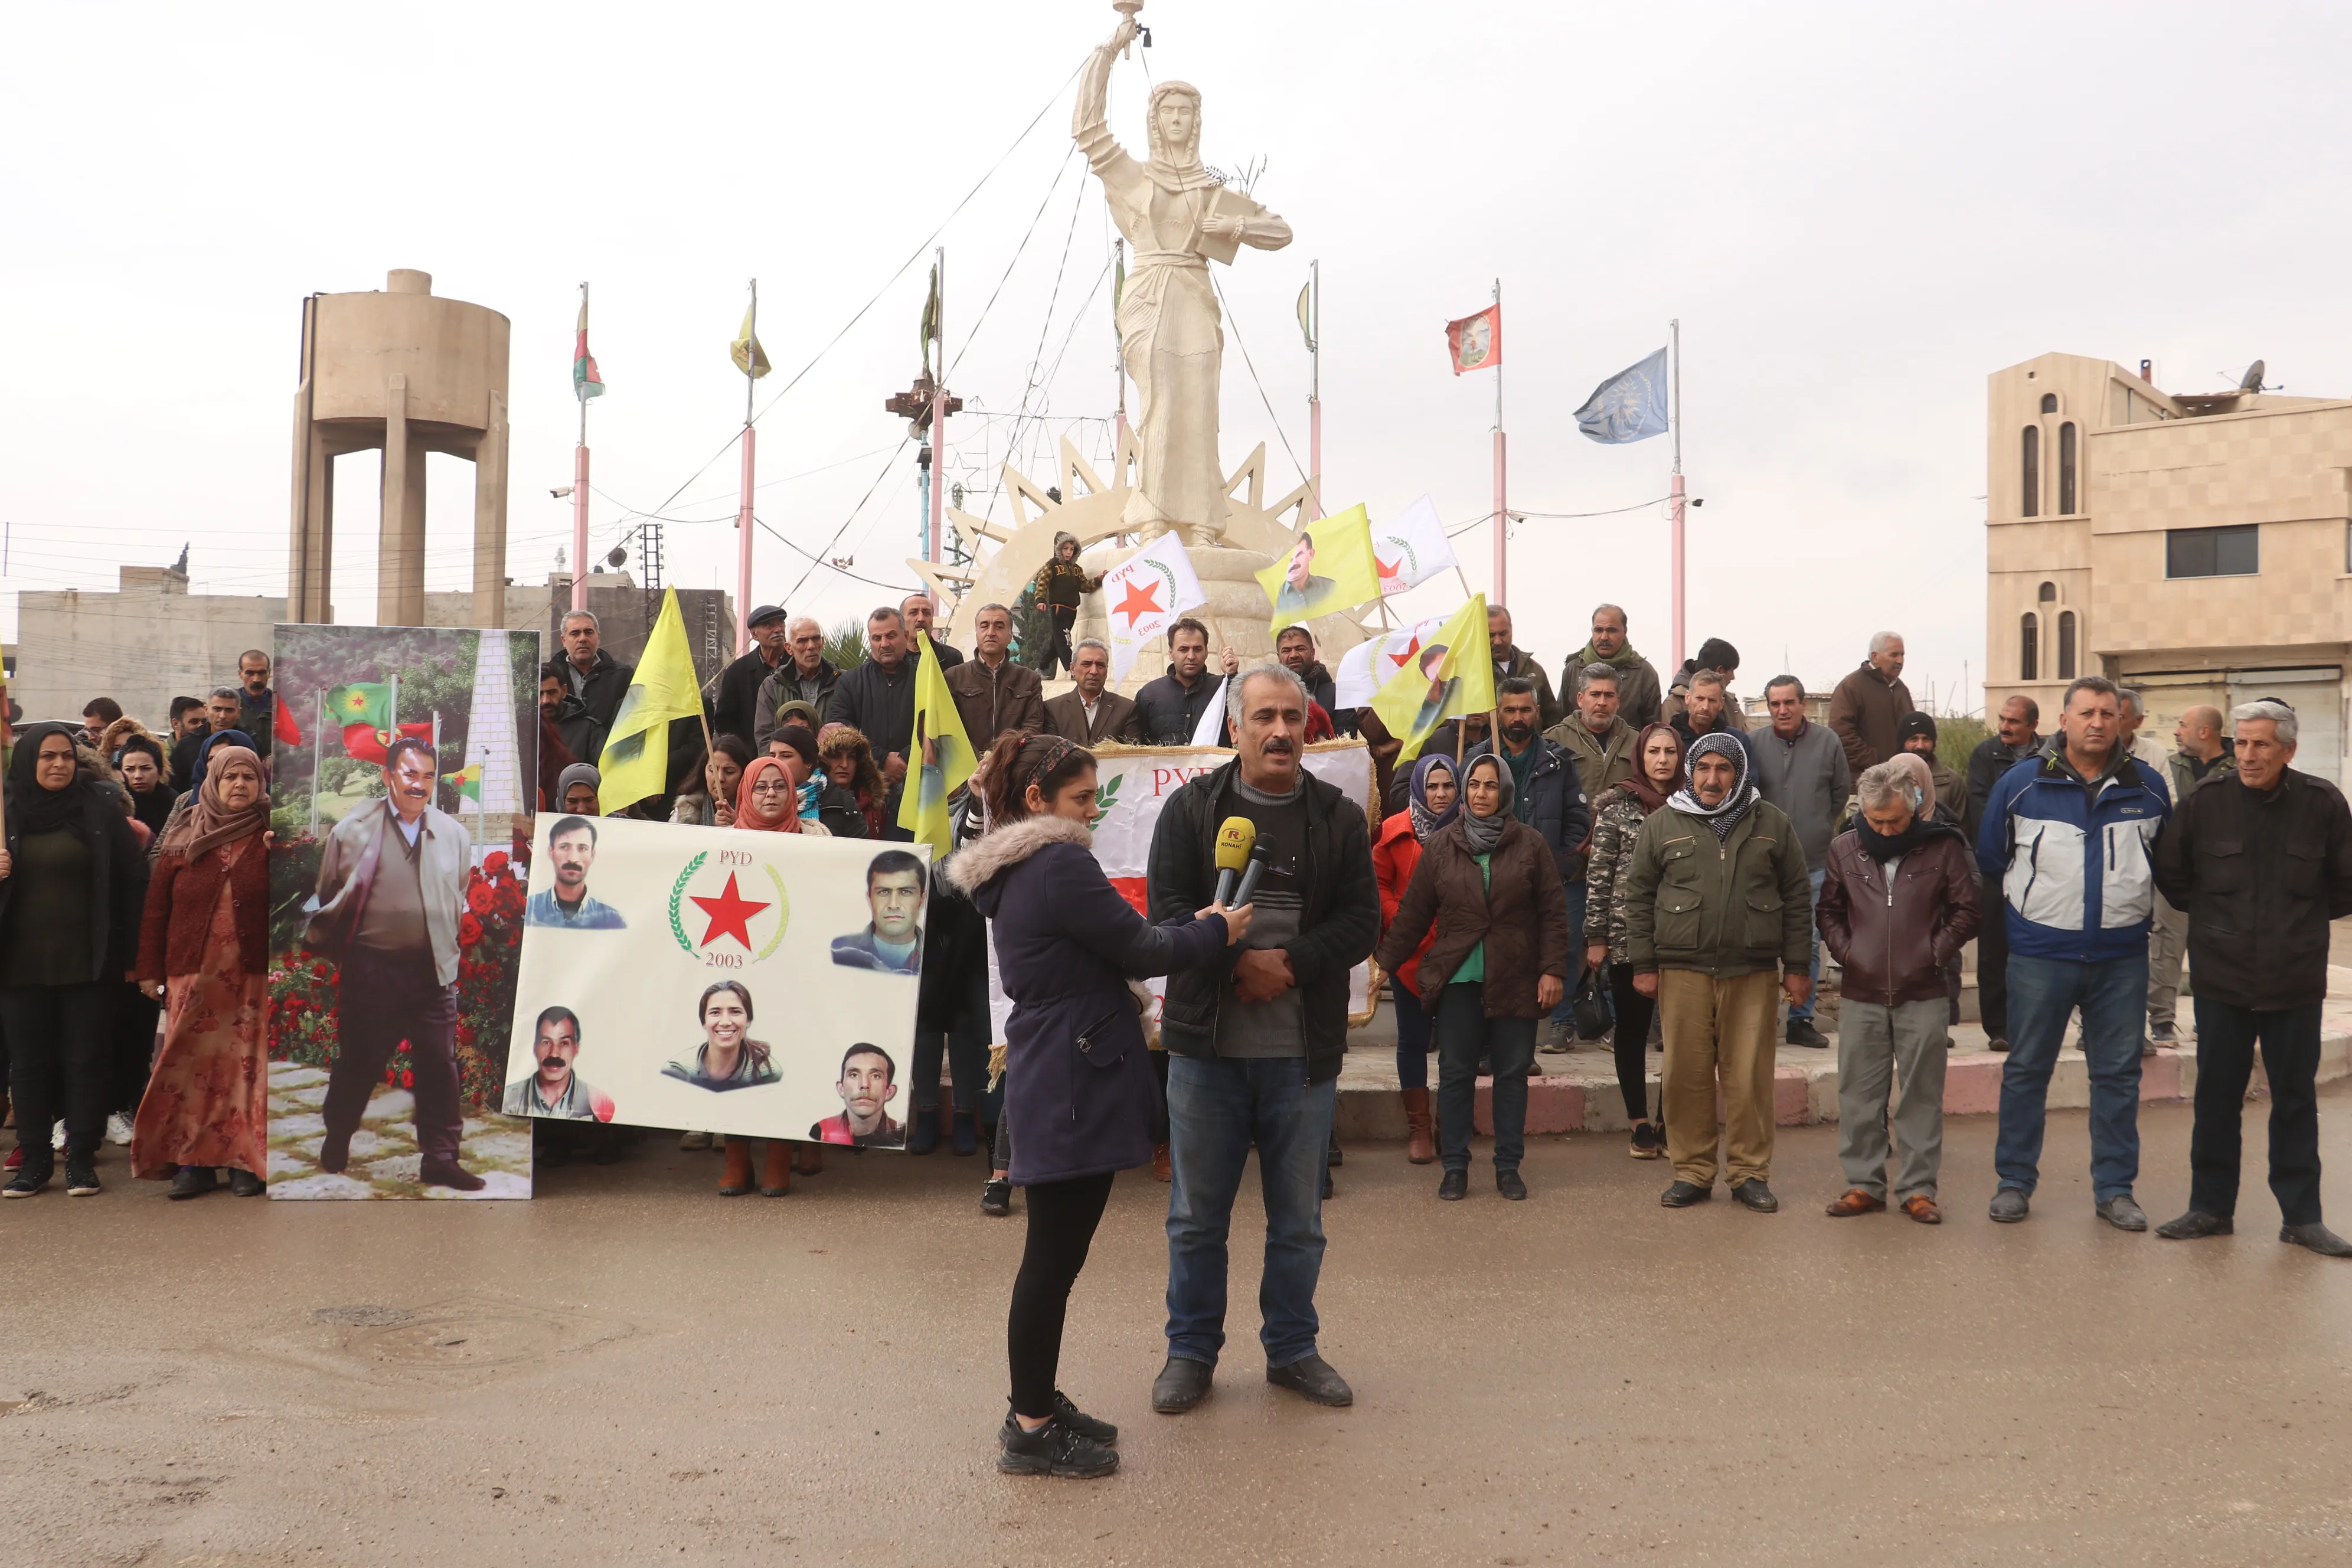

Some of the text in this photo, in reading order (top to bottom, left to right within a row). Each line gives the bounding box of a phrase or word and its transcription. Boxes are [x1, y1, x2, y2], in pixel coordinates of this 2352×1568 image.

[1152, 767, 1217, 796] PY
[720, 850, 753, 866] PYD
[705, 952, 743, 969] 2003
